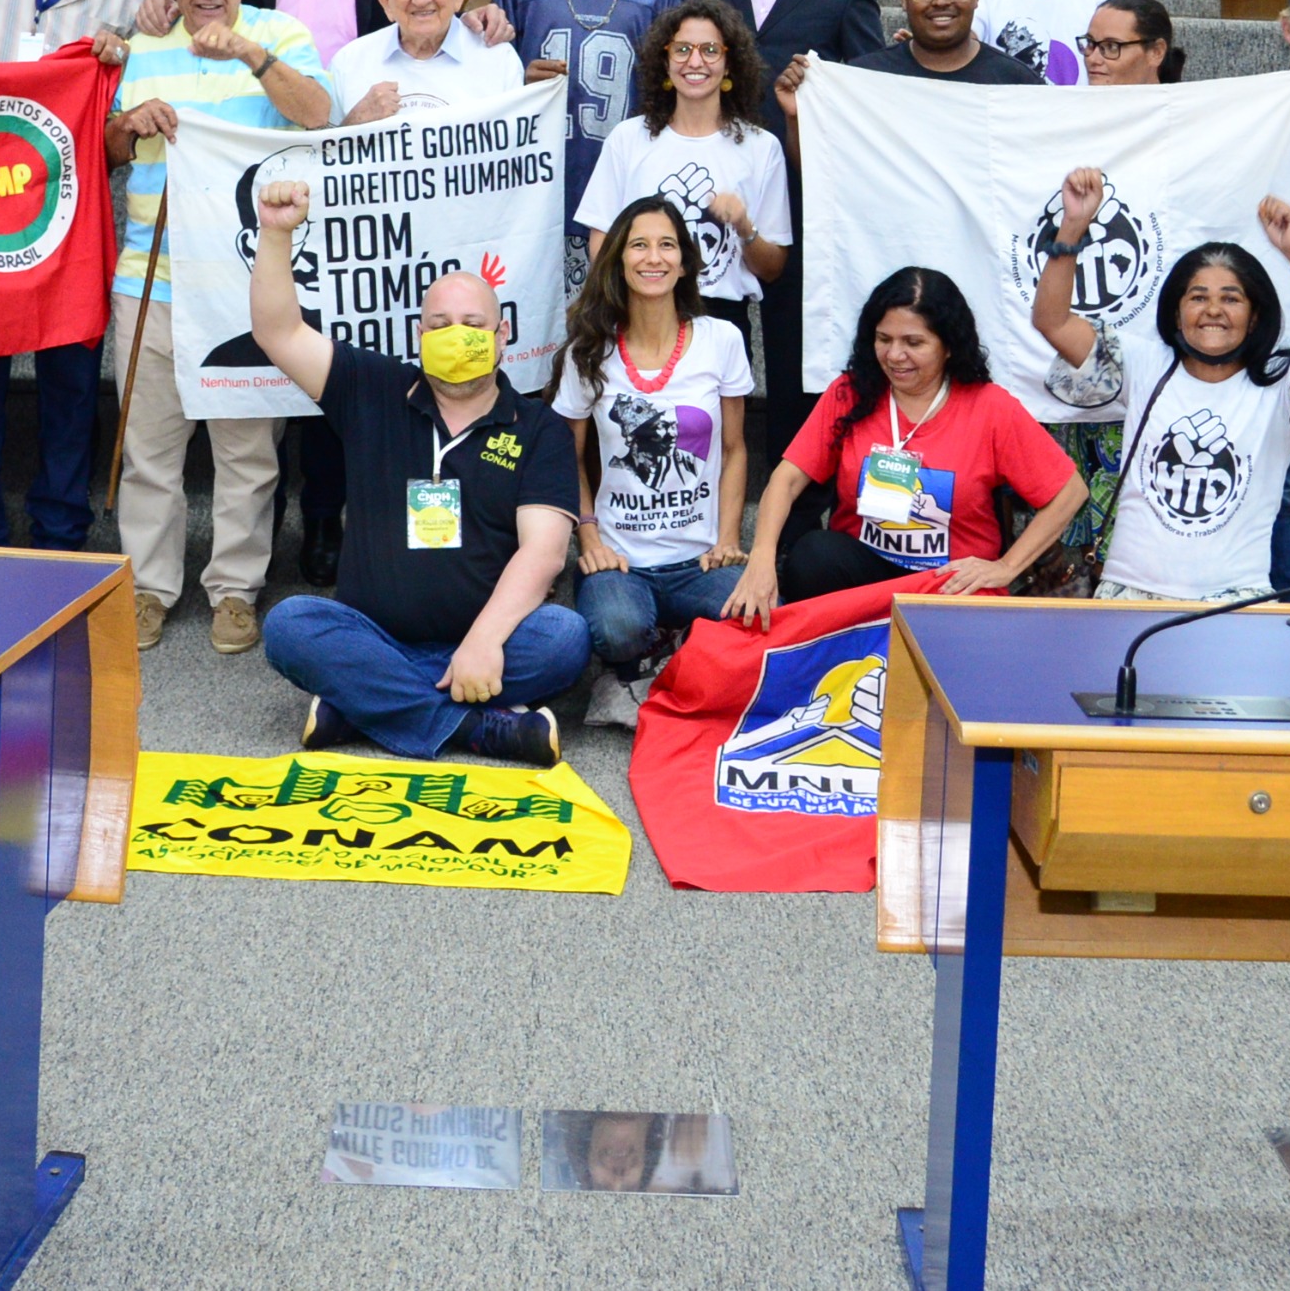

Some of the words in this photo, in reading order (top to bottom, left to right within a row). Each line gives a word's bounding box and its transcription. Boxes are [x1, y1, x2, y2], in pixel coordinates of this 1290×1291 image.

[321, 122, 414, 167] COMITÊ
[422, 119, 509, 159] GOIANO
[516, 113, 540, 148] DE
[42, 118, 73, 200] POPULARES
[323, 167, 436, 207] DIREITOS
[444, 151, 554, 197] HUMANOS
[324, 212, 413, 263] DOM
[1149, 212, 1164, 252] Direitos
[1012, 233, 1023, 288] Movimento
[1020, 290, 1030, 303] de
[1156, 257, 1164, 272] por
[200, 376, 249, 388] Nenhum
[253, 376, 291, 387] Direito
[480, 450, 516, 471] CONAM
[877, 459, 911, 474] CNDH
[610, 482, 711, 511] MULHERES
[615, 522, 656, 531] DIREITO
[659, 519, 667, 530] À
[670, 513, 704, 529] CIDADE
[624, 512, 638, 521] EM
[641, 511, 669, 521] LUTA
[864, 521, 945, 554] MNLM
[727, 765, 877, 794] MNL
[728, 796, 752, 807] DE
[757, 797, 801, 810] LUTA
[805, 801, 849, 814] PELA
[137, 817, 574, 859] CONAM
